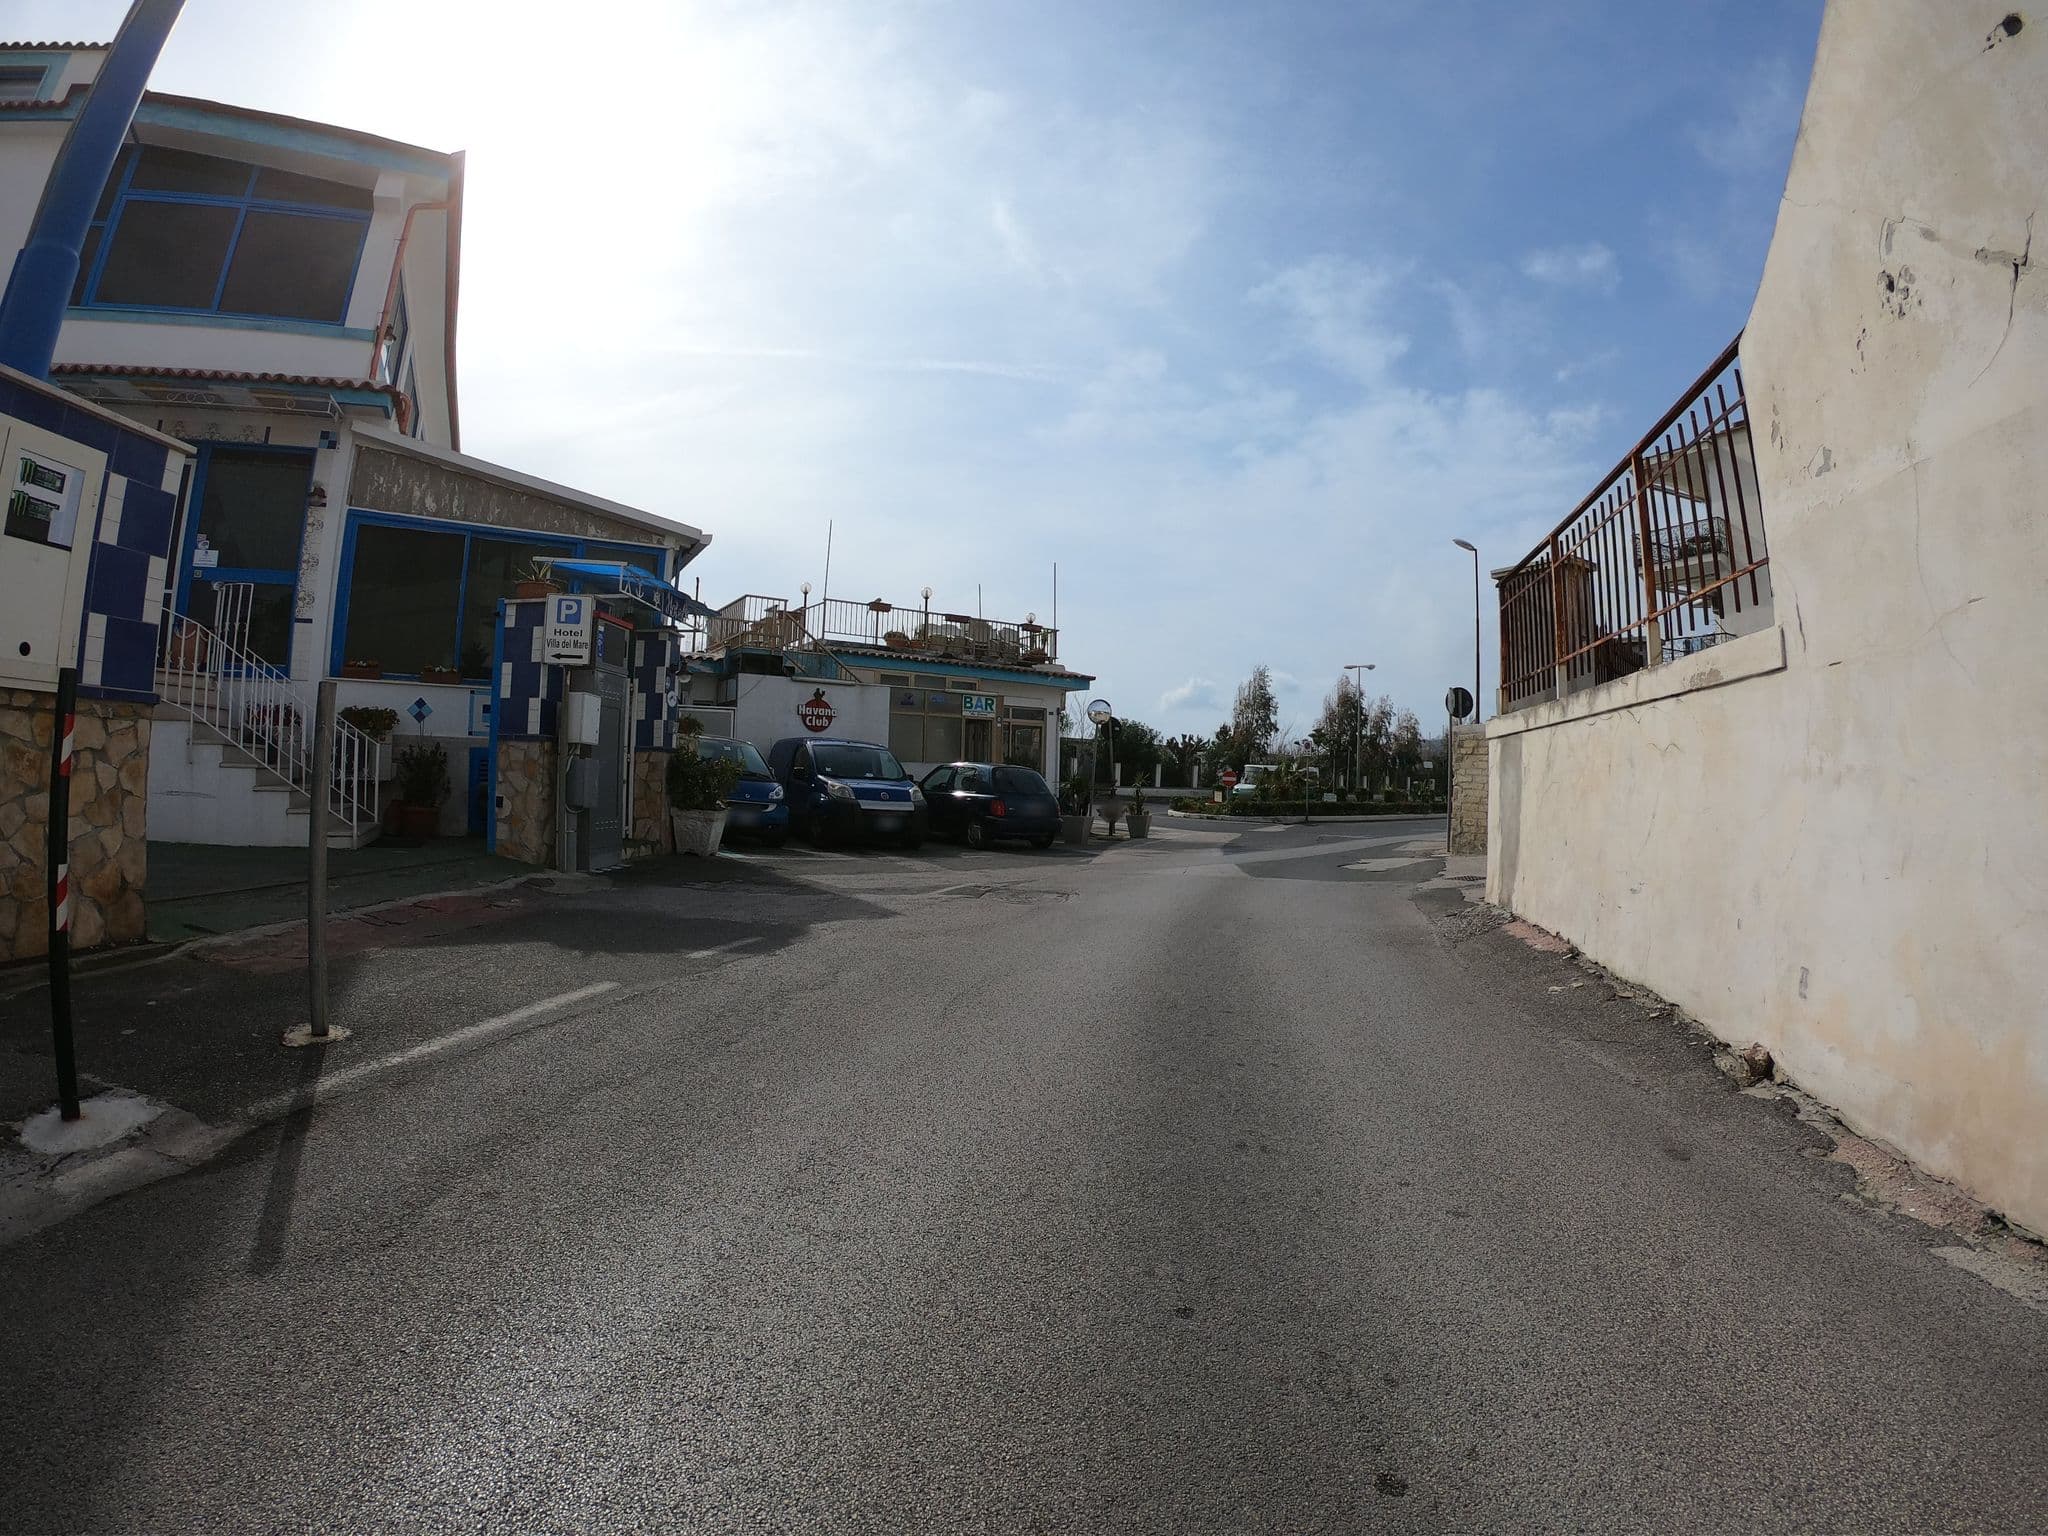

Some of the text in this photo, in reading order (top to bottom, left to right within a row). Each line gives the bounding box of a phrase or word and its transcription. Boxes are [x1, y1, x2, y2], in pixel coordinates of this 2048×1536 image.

[560, 600, 578, 622] P
[553, 628, 583, 637] Hotel
[546, 638, 589, 650] Villa del Mare
[963, 695, 995, 711] BAR
[798, 704, 838, 717] Havana
[806, 715, 829, 727] Club
